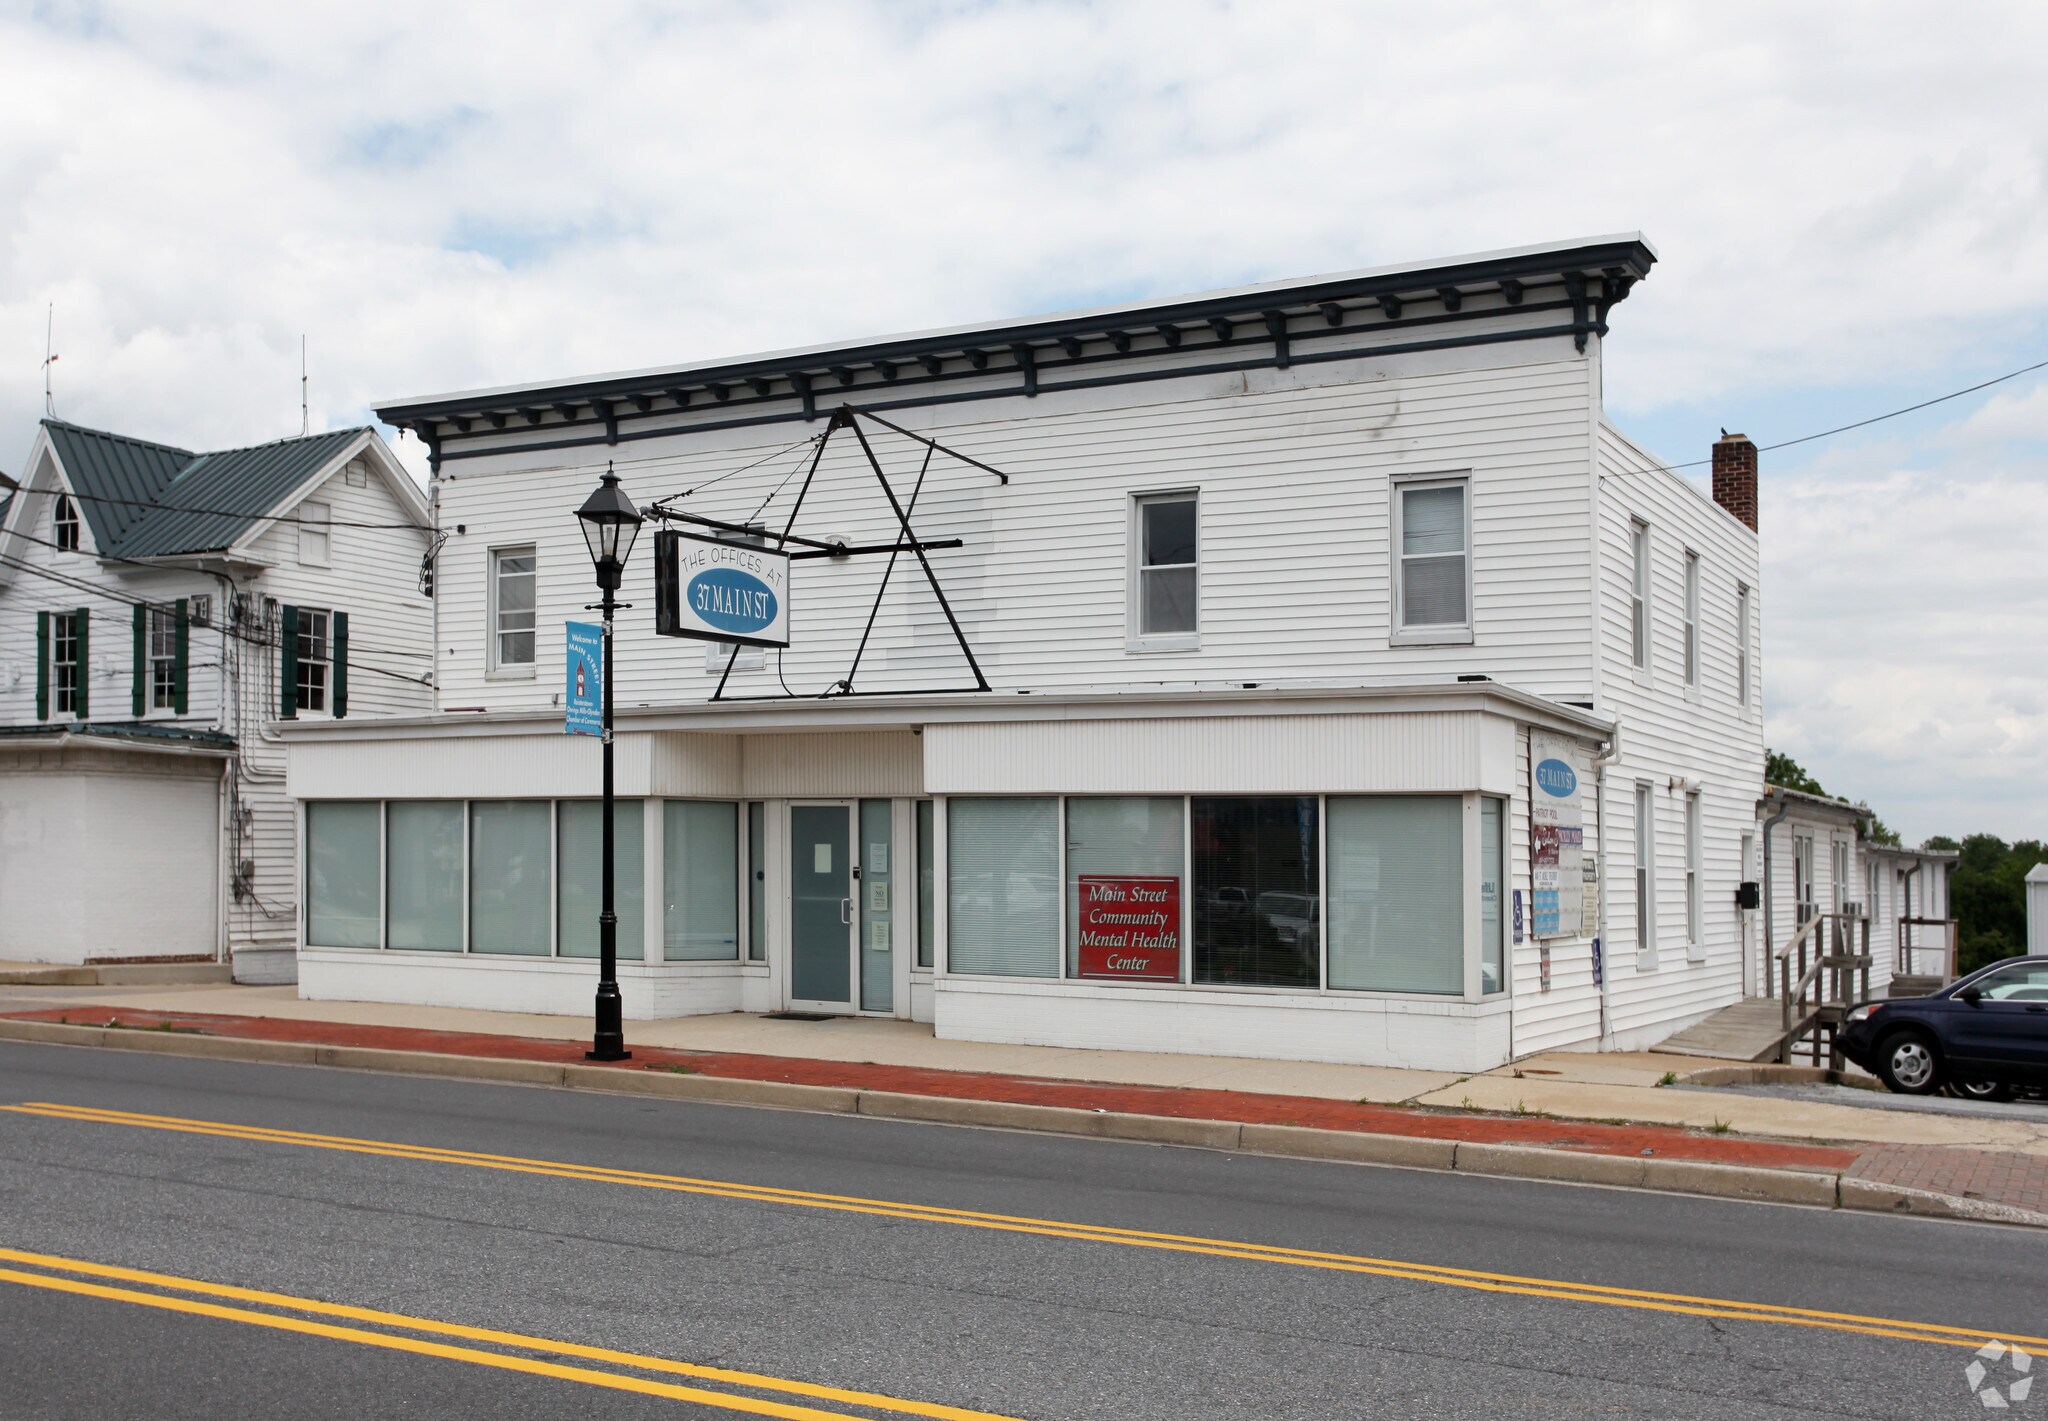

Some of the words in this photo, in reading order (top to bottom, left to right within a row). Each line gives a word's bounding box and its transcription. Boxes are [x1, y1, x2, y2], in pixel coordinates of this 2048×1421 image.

[682, 549, 706, 573] THE
[710, 547, 762, 573] OFFICES
[766, 568, 783, 587] AT
[696, 583, 710, 611] 37
[712, 585, 752, 618] MAIN
[754, 591, 769, 620] ST
[571, 634, 592, 644] Welcome
[568, 643, 586, 656] MAIN
[586, 654, 600, 685] STREET
[1540, 768, 1546, 785] 37
[1547, 768, 1566, 788] MAIN
[1089, 885, 1126, 902] Main
[1130, 886, 1168, 902] Street
[1089, 908, 1168, 932] Community
[1080, 930, 1128, 947] Mental
[1131, 931, 1177, 948] Health
[1106, 953, 1150, 970] Center
